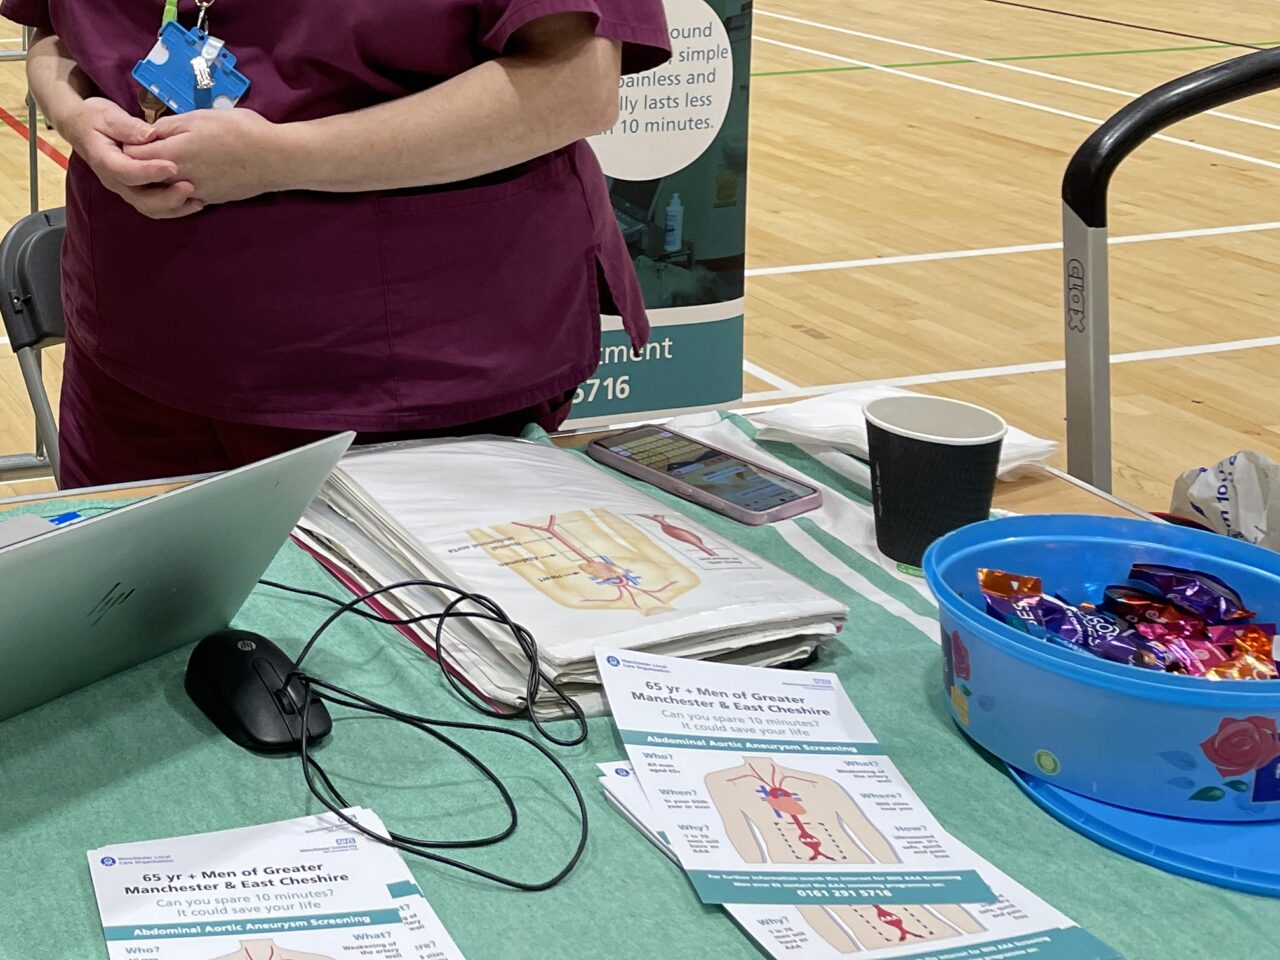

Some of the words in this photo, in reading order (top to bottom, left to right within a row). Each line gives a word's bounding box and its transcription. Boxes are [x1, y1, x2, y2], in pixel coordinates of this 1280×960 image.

[670, 22, 712, 39] ound
[679, 44, 728, 64] simple
[619, 72, 681, 88] painless
[686, 68, 716, 84] and
[644, 95, 679, 110] lasts
[685, 93, 712, 108] less
[621, 119, 639, 134] 10
[645, 117, 714, 132] minutes.
[124, 881, 221, 895] Manchester
[225, 880, 237, 890] &
[241, 876, 276, 888] East
[279, 872, 349, 886] Cheshire
[142, 872, 161, 883] 65
[167, 872, 184, 885] yr
[187, 873, 196, 881] +
[201, 867, 237, 880] Men
[242, 865, 259, 877] of
[264, 862, 323, 875] Greater
